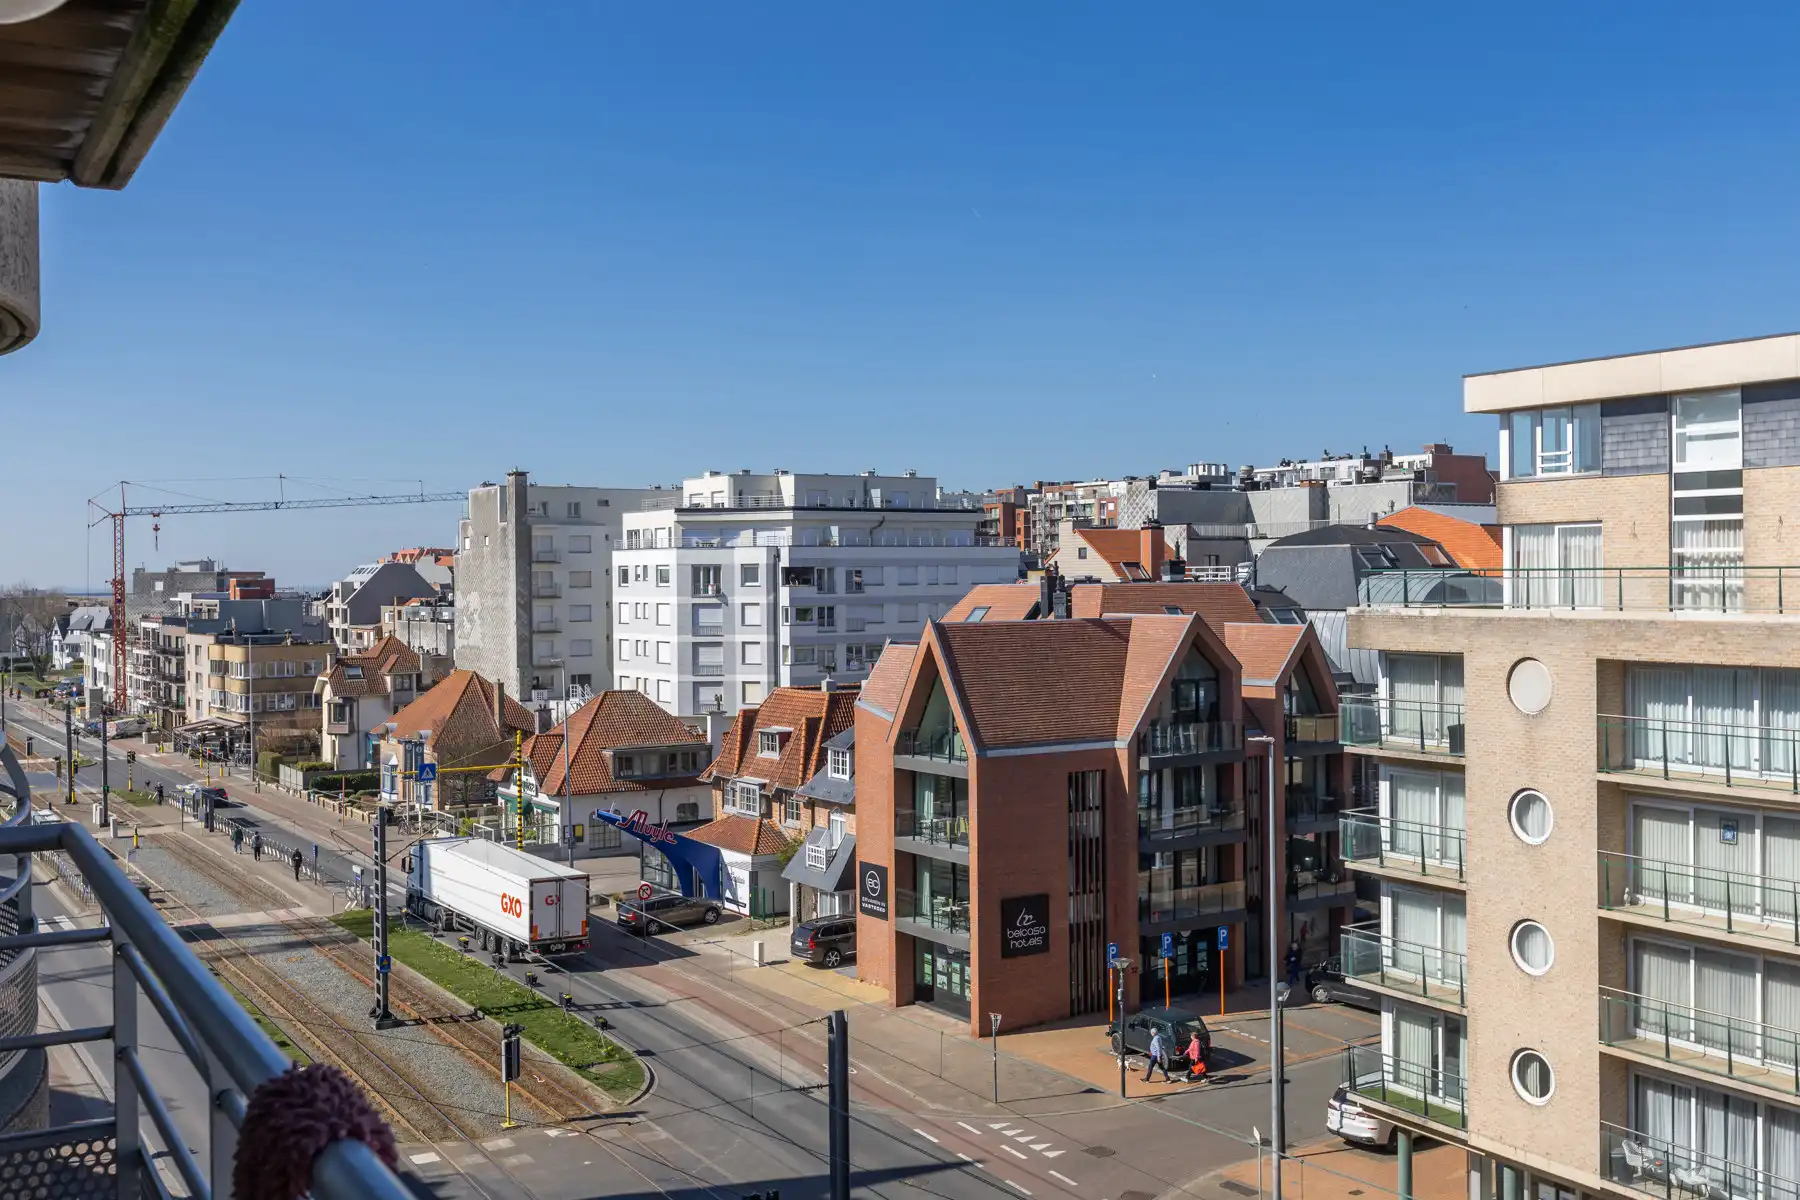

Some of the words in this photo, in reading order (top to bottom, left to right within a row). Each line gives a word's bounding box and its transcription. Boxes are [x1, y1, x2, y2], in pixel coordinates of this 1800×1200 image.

[501, 892, 523, 919] GXO
[1006, 926, 1046, 939] belcasa
[1220, 929, 1227, 942] P
[1010, 936, 1043, 949] hotels
[1164, 936, 1172, 949] P
[1110, 946, 1117, 960] P
